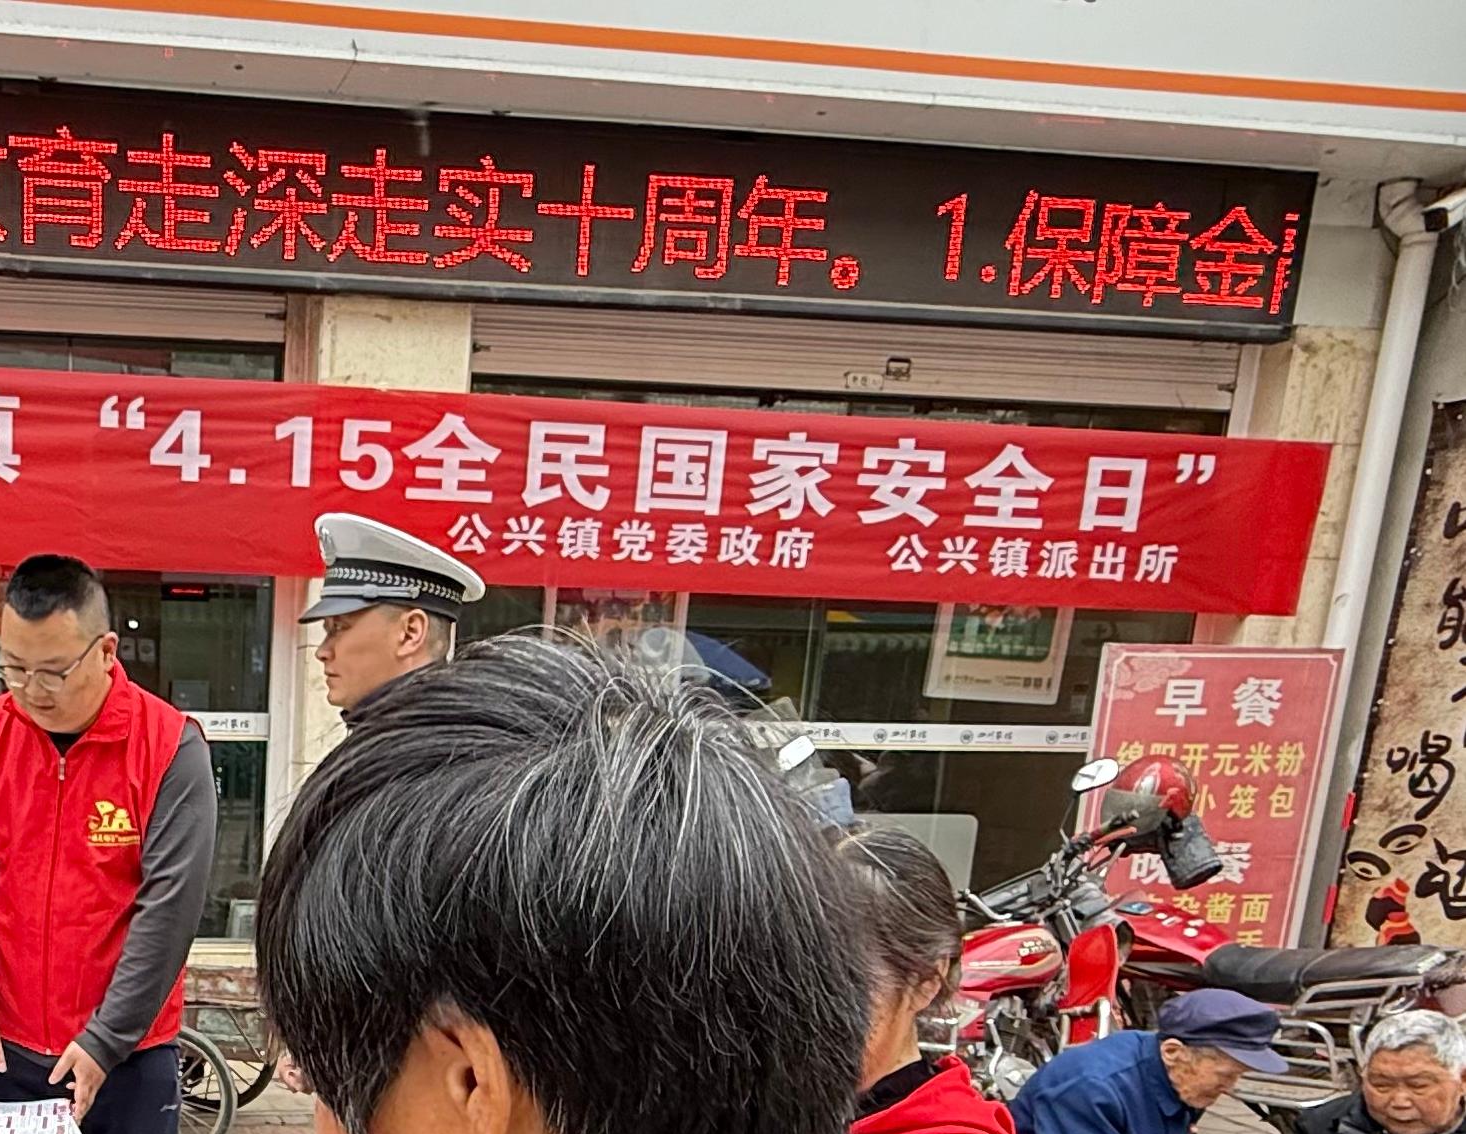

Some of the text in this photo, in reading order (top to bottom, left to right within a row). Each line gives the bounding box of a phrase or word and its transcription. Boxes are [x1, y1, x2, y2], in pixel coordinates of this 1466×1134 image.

[937, 190, 1300, 315] 1.保障金
[448, 512, 1179, 585] 公兴镇党委政府 公兴镇派出所
[1155, 677, 1283, 727] 早餐
